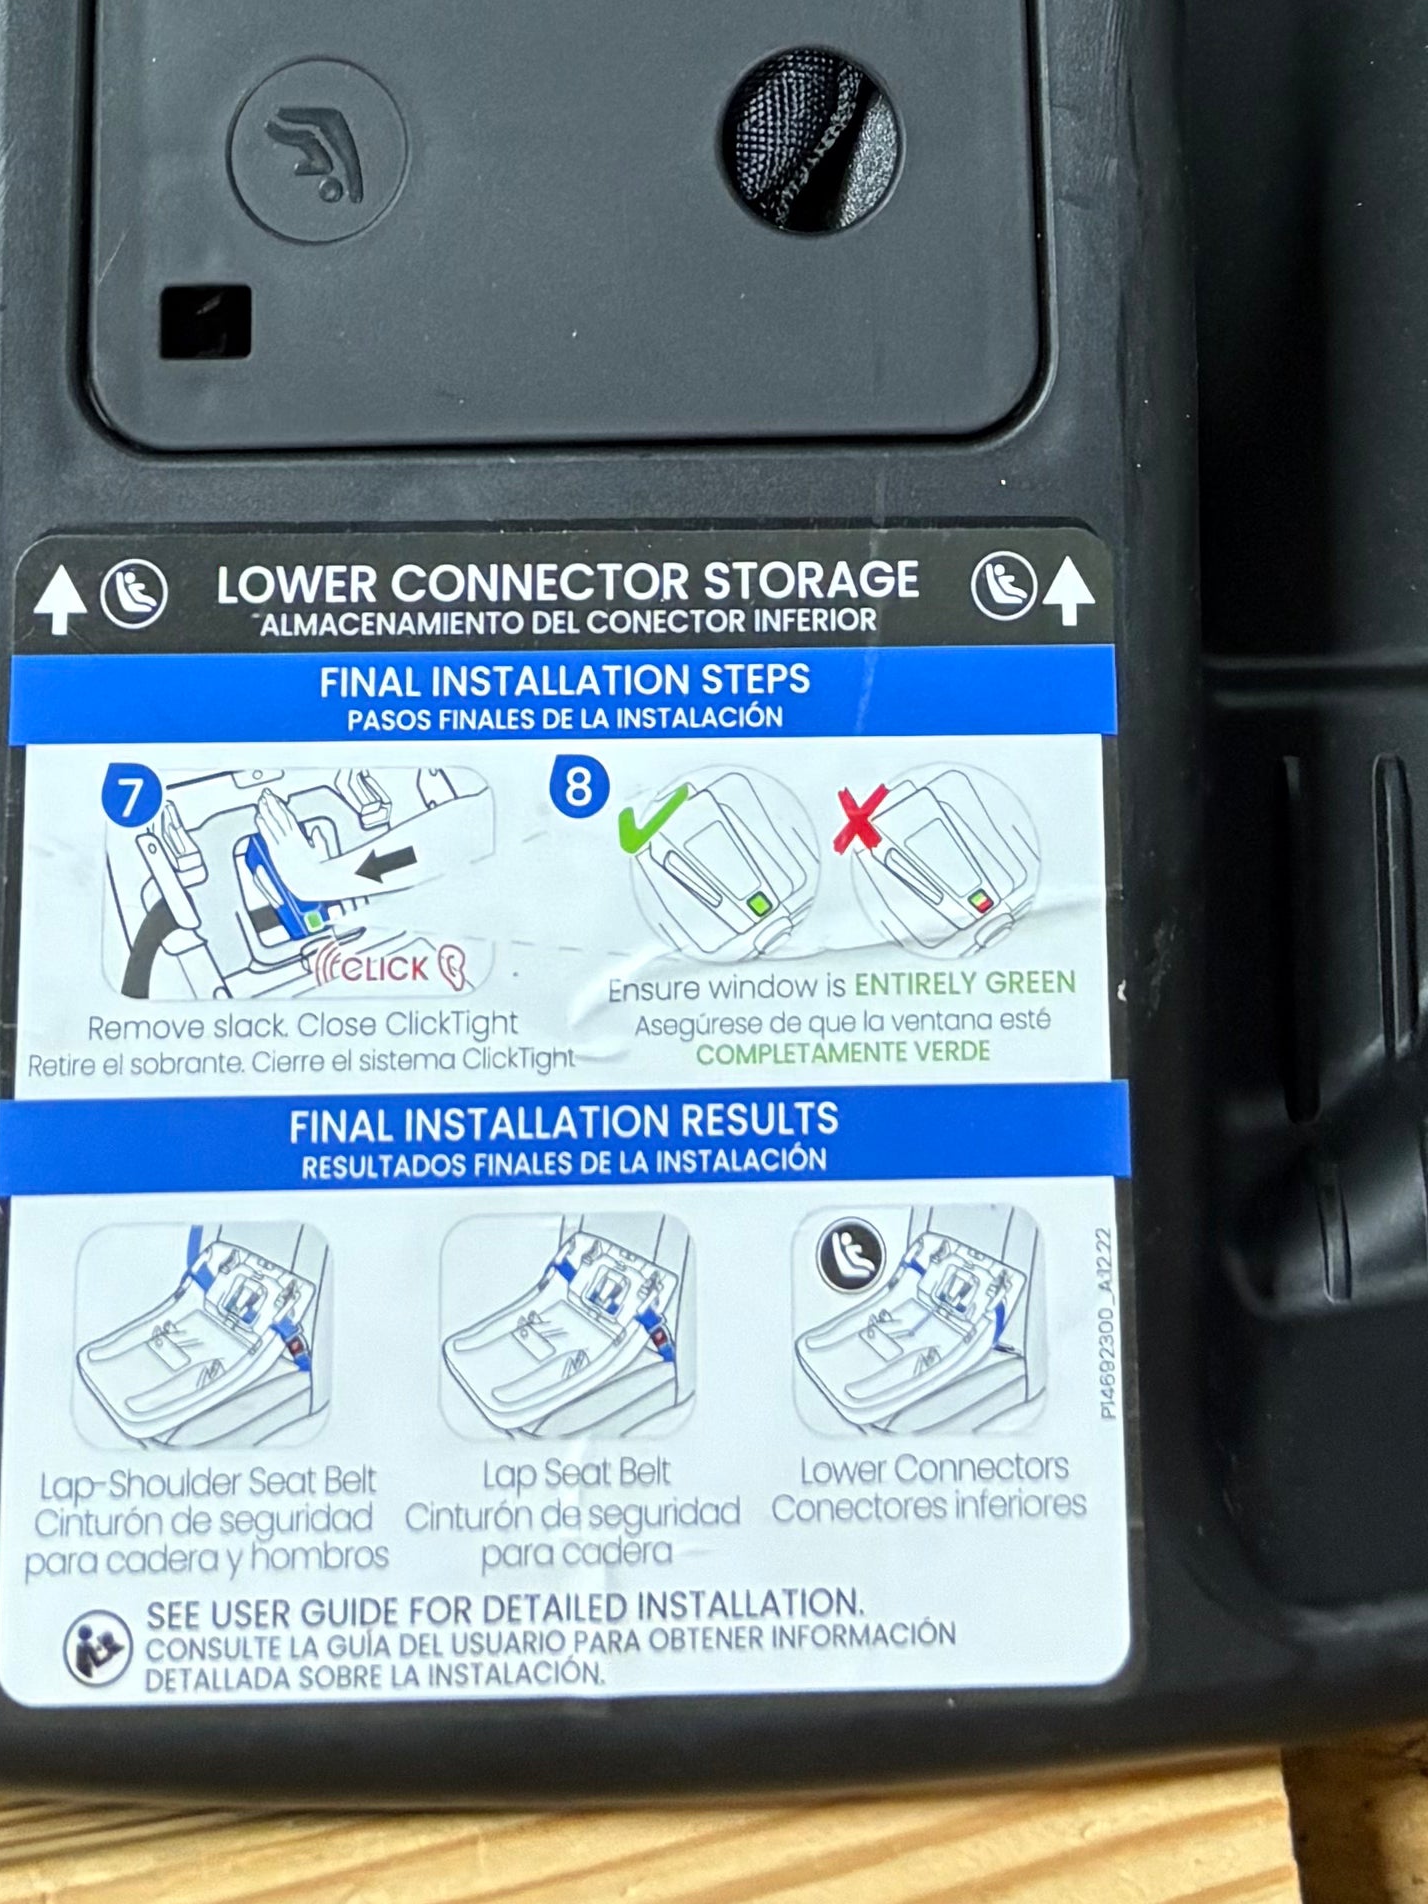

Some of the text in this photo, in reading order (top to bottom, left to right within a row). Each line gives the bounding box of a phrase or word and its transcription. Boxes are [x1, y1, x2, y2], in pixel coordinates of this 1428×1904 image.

[217, 559, 920, 604] LOWER CONNECTOR STORAGE
[320, 662, 810, 698] FINAL INSTALLATION STEPS
[117, 777, 144, 818] 7
[565, 765, 592, 807] 8
[607, 969, 1076, 1004] Ensure window is ENTIRELY GREEN
[88, 1009, 519, 1043] Remove slack. Close ClickTight
[695, 1039, 990, 1066] COMPLETAMENTE VERDE
[289, 1100, 839, 1144] FINAL INSTALLATION RESULTS
[483, 1455, 671, 1492] Lap Seat Belt
[800, 1452, 1070, 1486] Lower Connectors
[147, 1586, 864, 1631] SEE USER GUIDE FOR DETAILED INSTALLATION.
